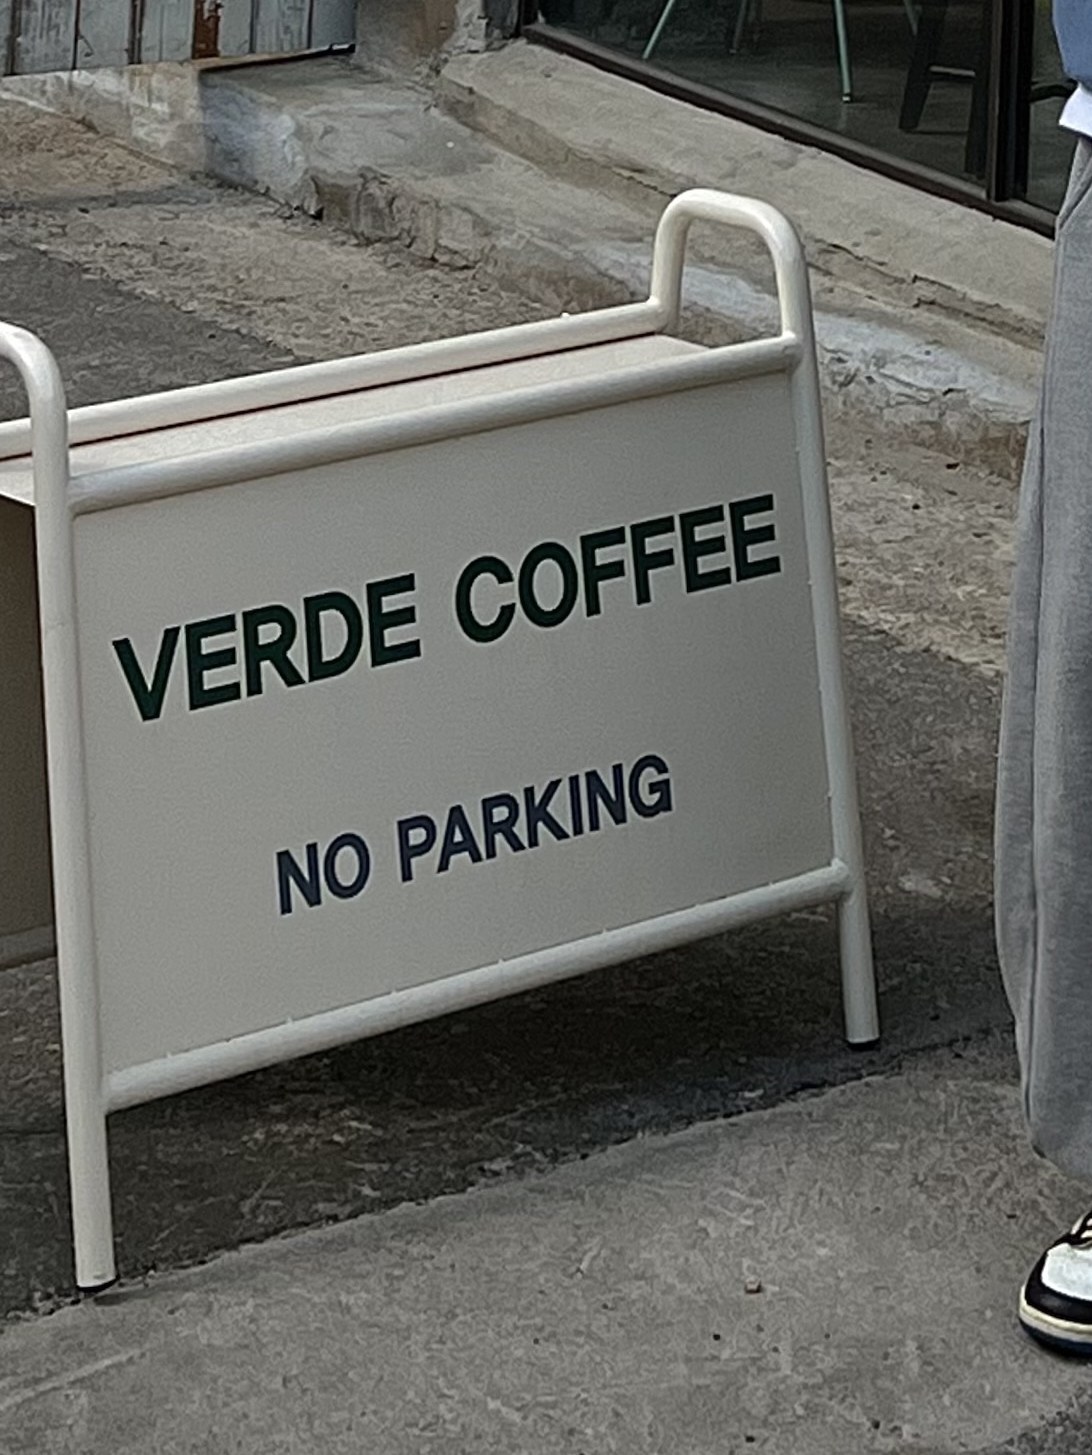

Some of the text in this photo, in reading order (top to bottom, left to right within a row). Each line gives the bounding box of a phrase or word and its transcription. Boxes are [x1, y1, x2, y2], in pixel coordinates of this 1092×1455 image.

[111, 492, 782, 723] VERDE COFFEE
[275, 753, 673, 916] NO PARKING
